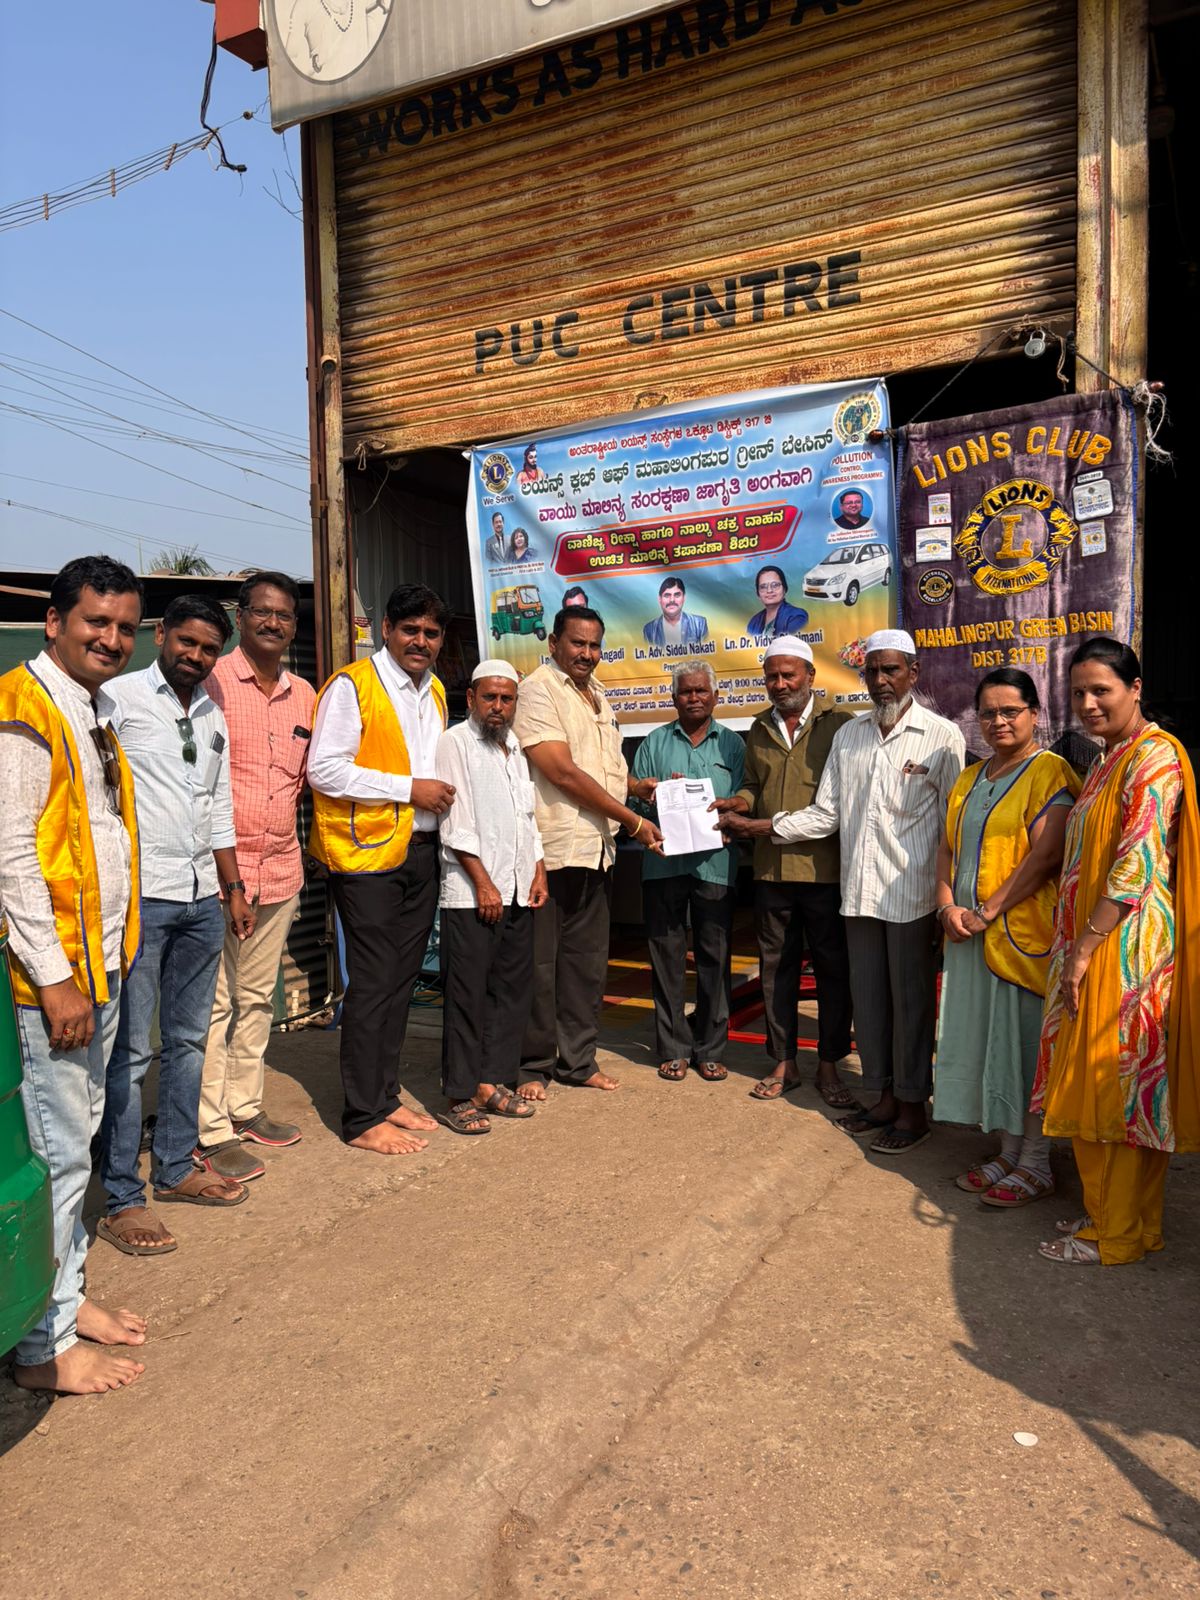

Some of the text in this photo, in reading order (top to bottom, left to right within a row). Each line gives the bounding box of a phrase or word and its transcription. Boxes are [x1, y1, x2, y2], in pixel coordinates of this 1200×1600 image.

[354, 65, 521, 158] WORKS
[532, 36, 603, 106] AS
[616, 0, 771, 79] HARD
[474, 250, 862, 375] PUC CENTRE
[745, 416, 760, 427] 317
[521, 473, 564, 498] ಲಯನ್ಸ್
[570, 468, 596, 495] ಕ್ಲಬ್
[636, 446, 729, 478] ಮಹಾಲಿಂಗಪುರ
[737, 438, 774, 469] ಗ್ರೀನ್
[782, 429, 833, 454] ಬೇಸಿನ್
[832, 451, 873, 465] POLLUTION
[840, 465, 862, 473] CONTROL
[913, 425, 1112, 489] LIONS CLUB
[851, 472, 883, 480] PROGRAMME
[495, 495, 515, 504] Serve
[539, 466, 812, 522] ವಾಯು ಮಾಲಿನ್ಯ ಸಂರಕ್ಷಣಾ ಜಾಗೃತಿ ಅಂಗವಾಗಿ
[987, 483, 1049, 512] LIONS
[567, 535, 605, 551] ವಾಣಿಜ್ಯ
[641, 526, 674, 541] ಹಾಗೂ
[679, 522, 713, 537] ನಾಲ್ಕು
[717, 516, 739, 532] ಚಕ್ರ
[745, 509, 784, 527] ವಾಹನ
[996, 514, 1034, 560] L
[589, 553, 624, 567] ಉಚಿತ
[673, 542, 723, 557] ತಪಾಸಣಾ
[729, 535, 758, 550] ಶಿಬಿರ
[983, 570, 1040, 589] INTERNATIONAL
[914, 611, 1114, 648] MAHALINGPUR GREEN BASIN
[635, 641, 715, 659] Ln. Adv. Siddu Nakati
[725, 638, 738, 650] Ln.
[740, 637, 752, 648] Dr.
[754, 635, 775, 647] Vidy
[972, 646, 1048, 668] DIST: 317B
[735, 679, 750, 687] 9:00
